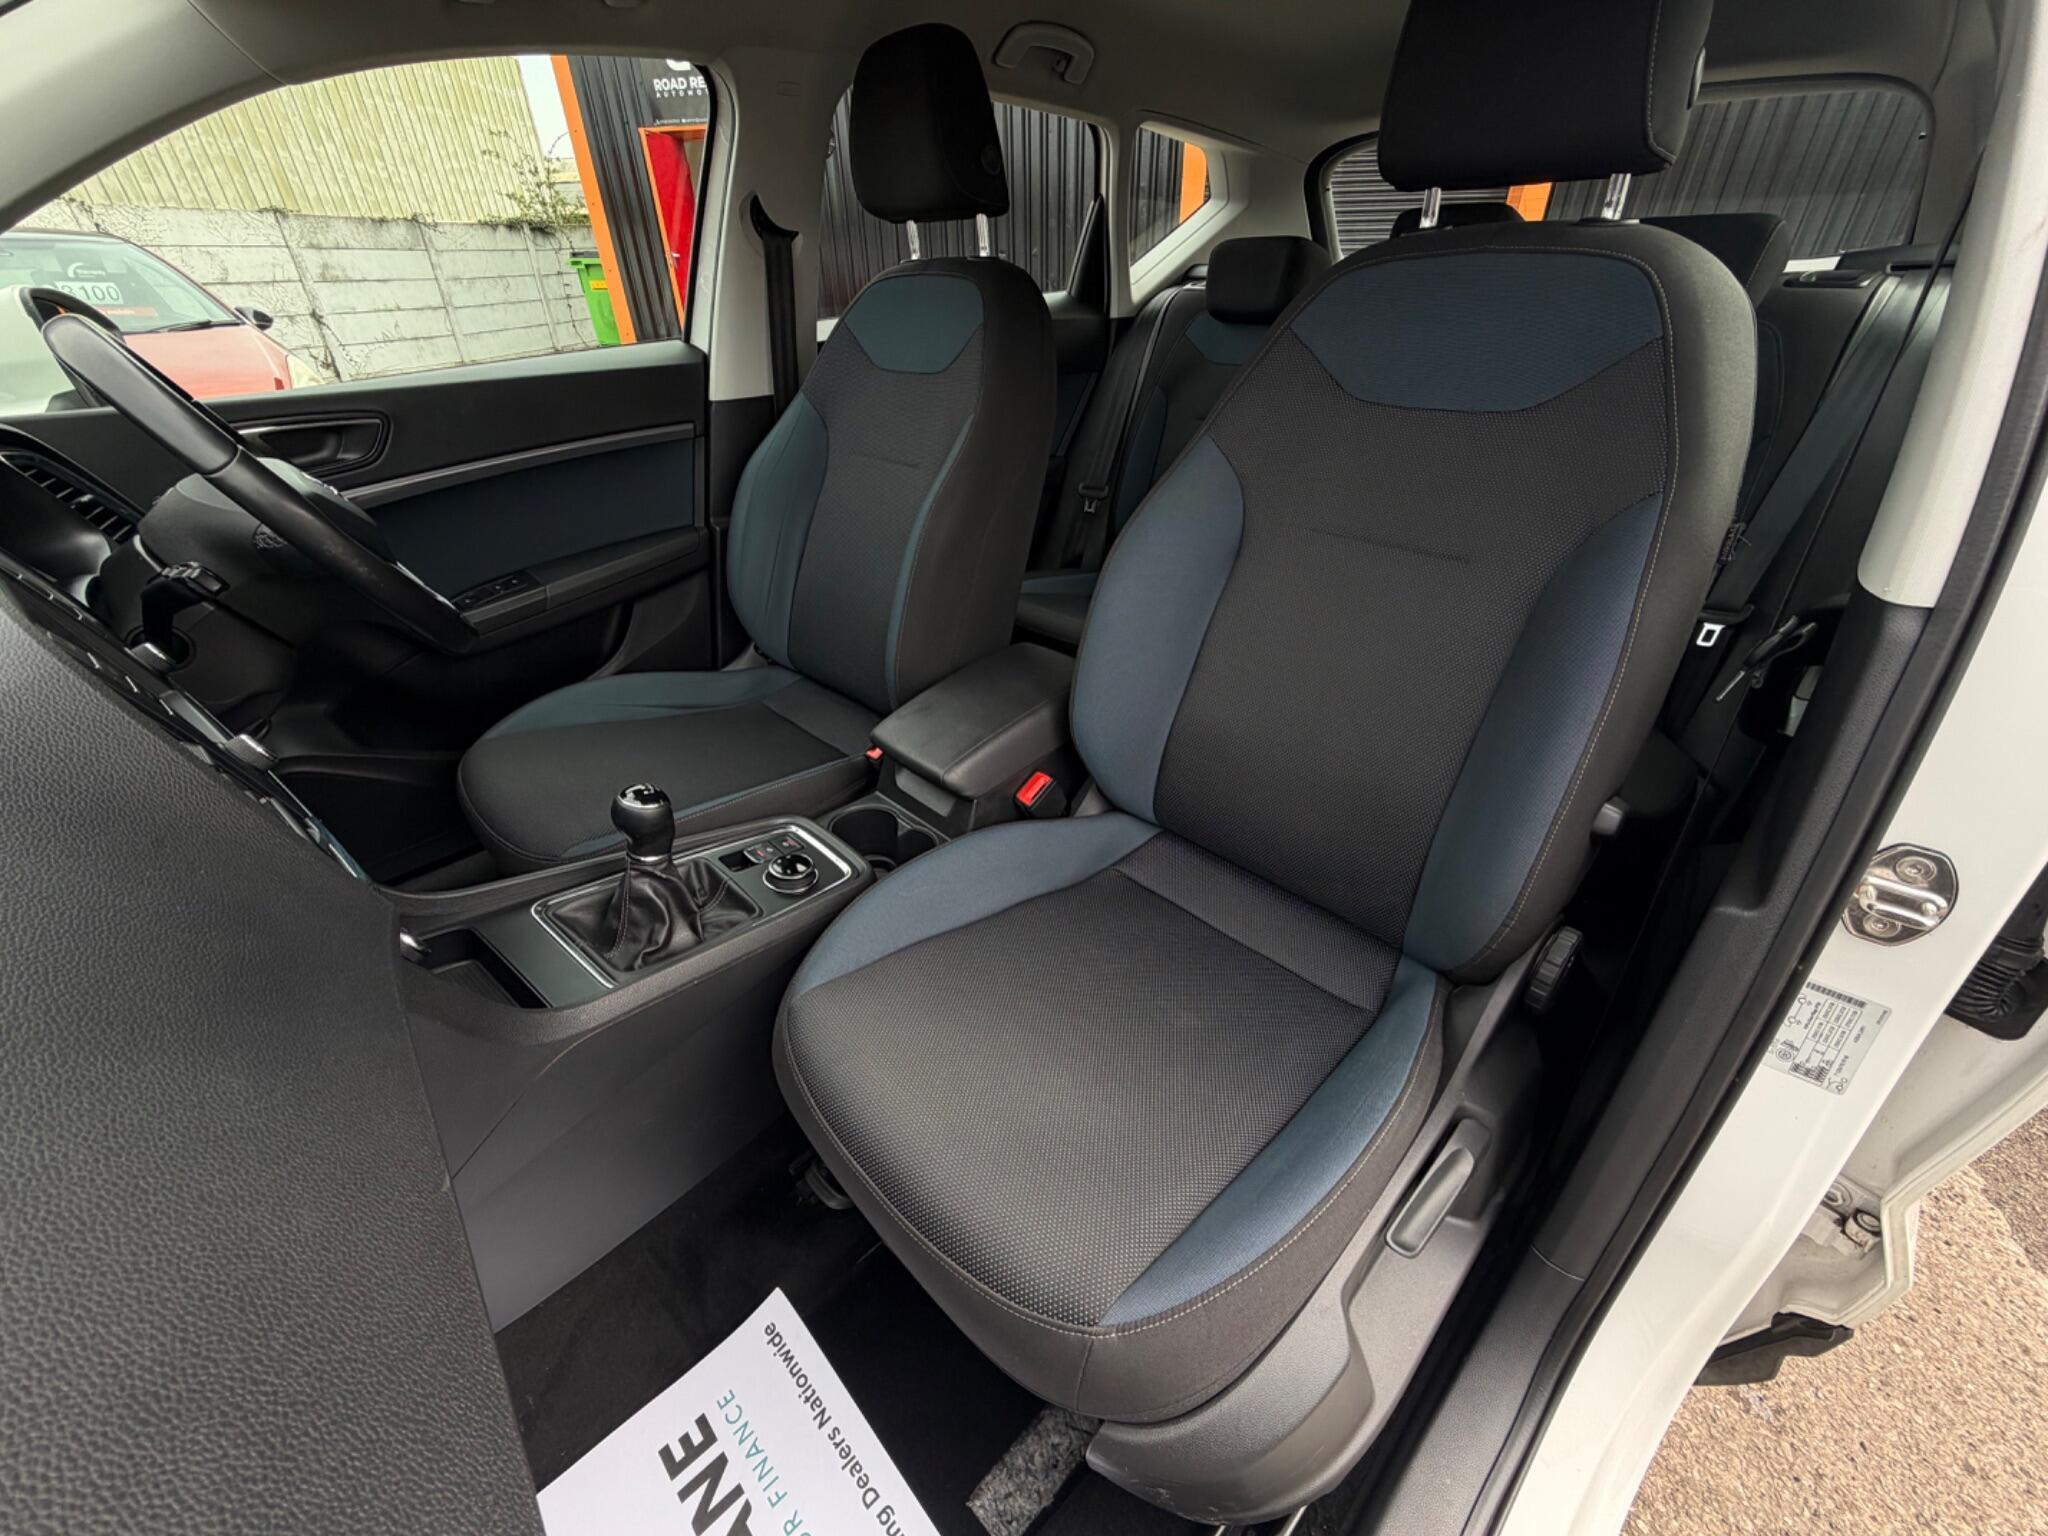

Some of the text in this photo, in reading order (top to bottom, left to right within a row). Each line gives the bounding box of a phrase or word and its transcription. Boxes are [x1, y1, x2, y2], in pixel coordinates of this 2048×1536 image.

[653, 77, 688, 91] ROAD
[716, 1389, 788, 1508] FINANCE
[764, 1322, 907, 1536] ng Dealers Nationwide
